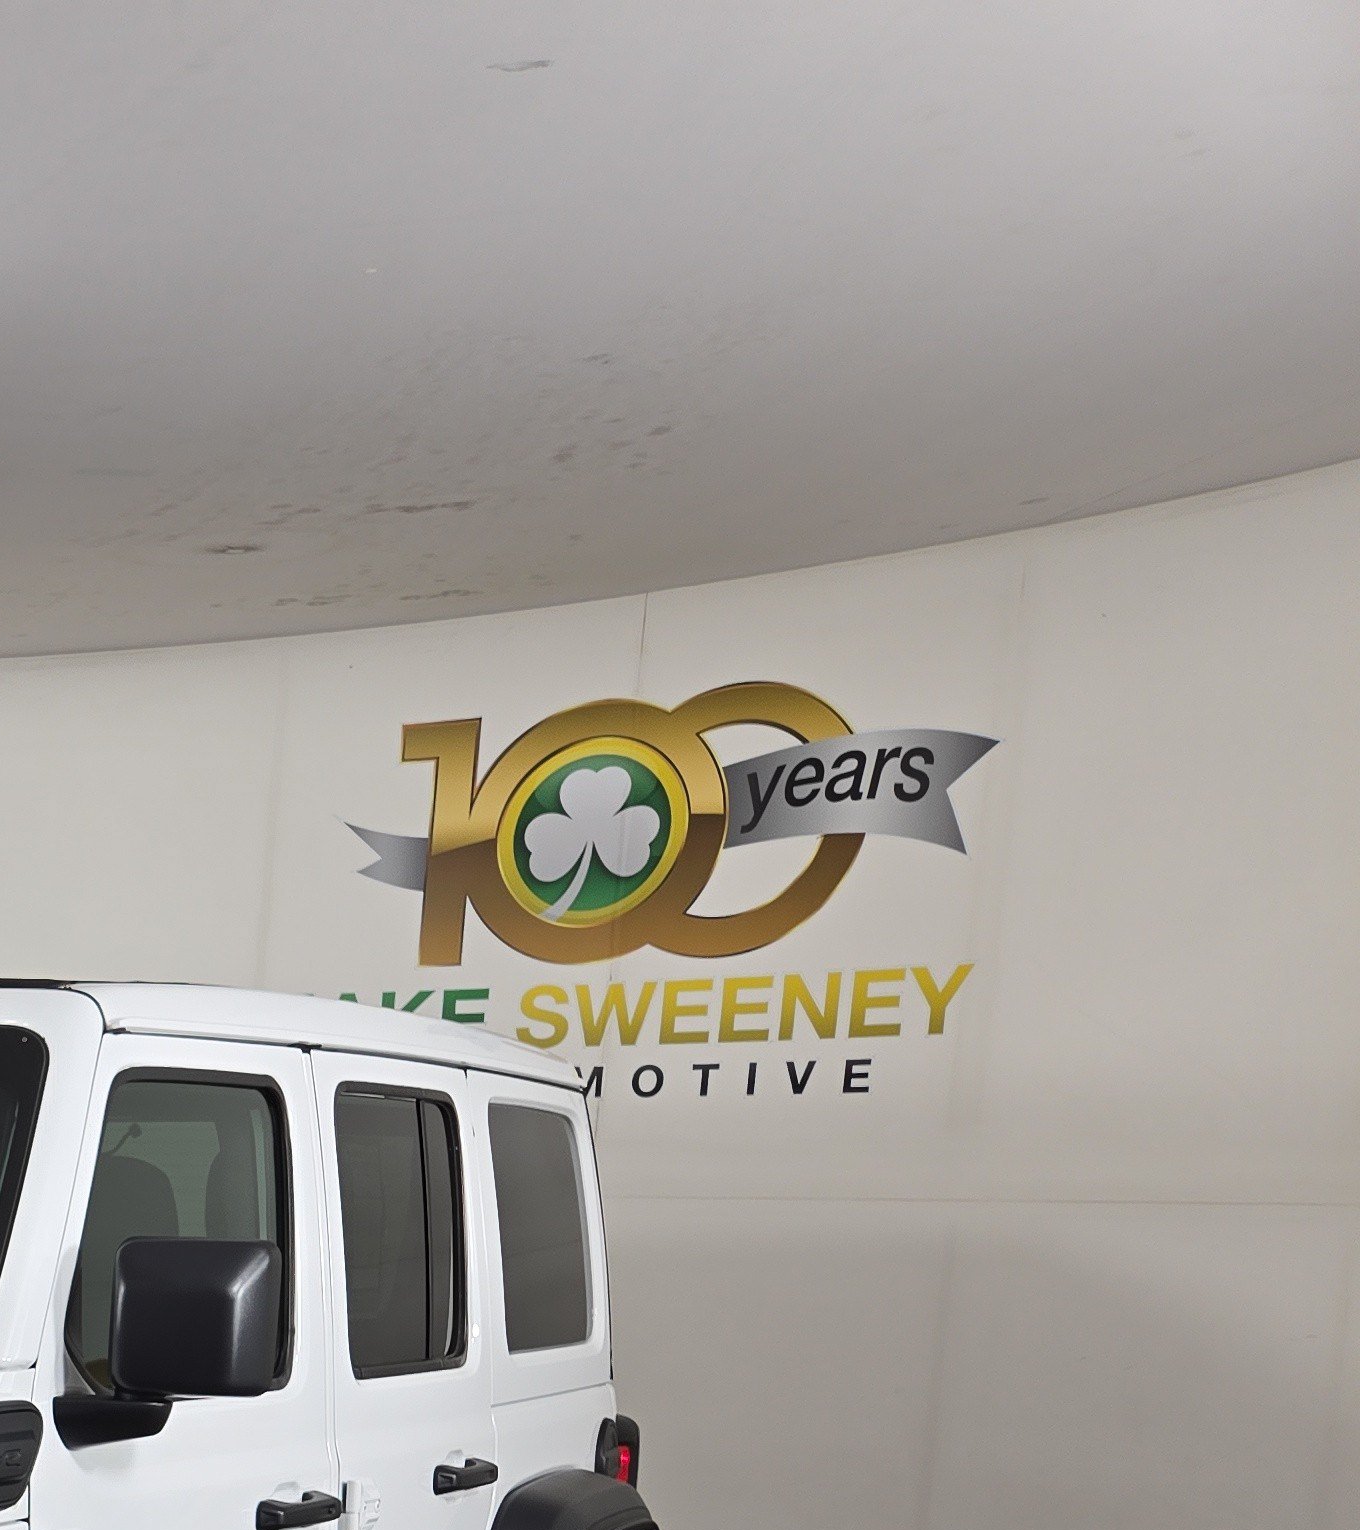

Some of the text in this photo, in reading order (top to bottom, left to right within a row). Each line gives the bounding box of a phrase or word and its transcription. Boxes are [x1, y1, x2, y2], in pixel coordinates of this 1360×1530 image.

[401, 681, 934, 966] 100 years
[516, 963, 975, 1049] SWEENEY
[574, 1059, 872, 1098] MOTIVE
